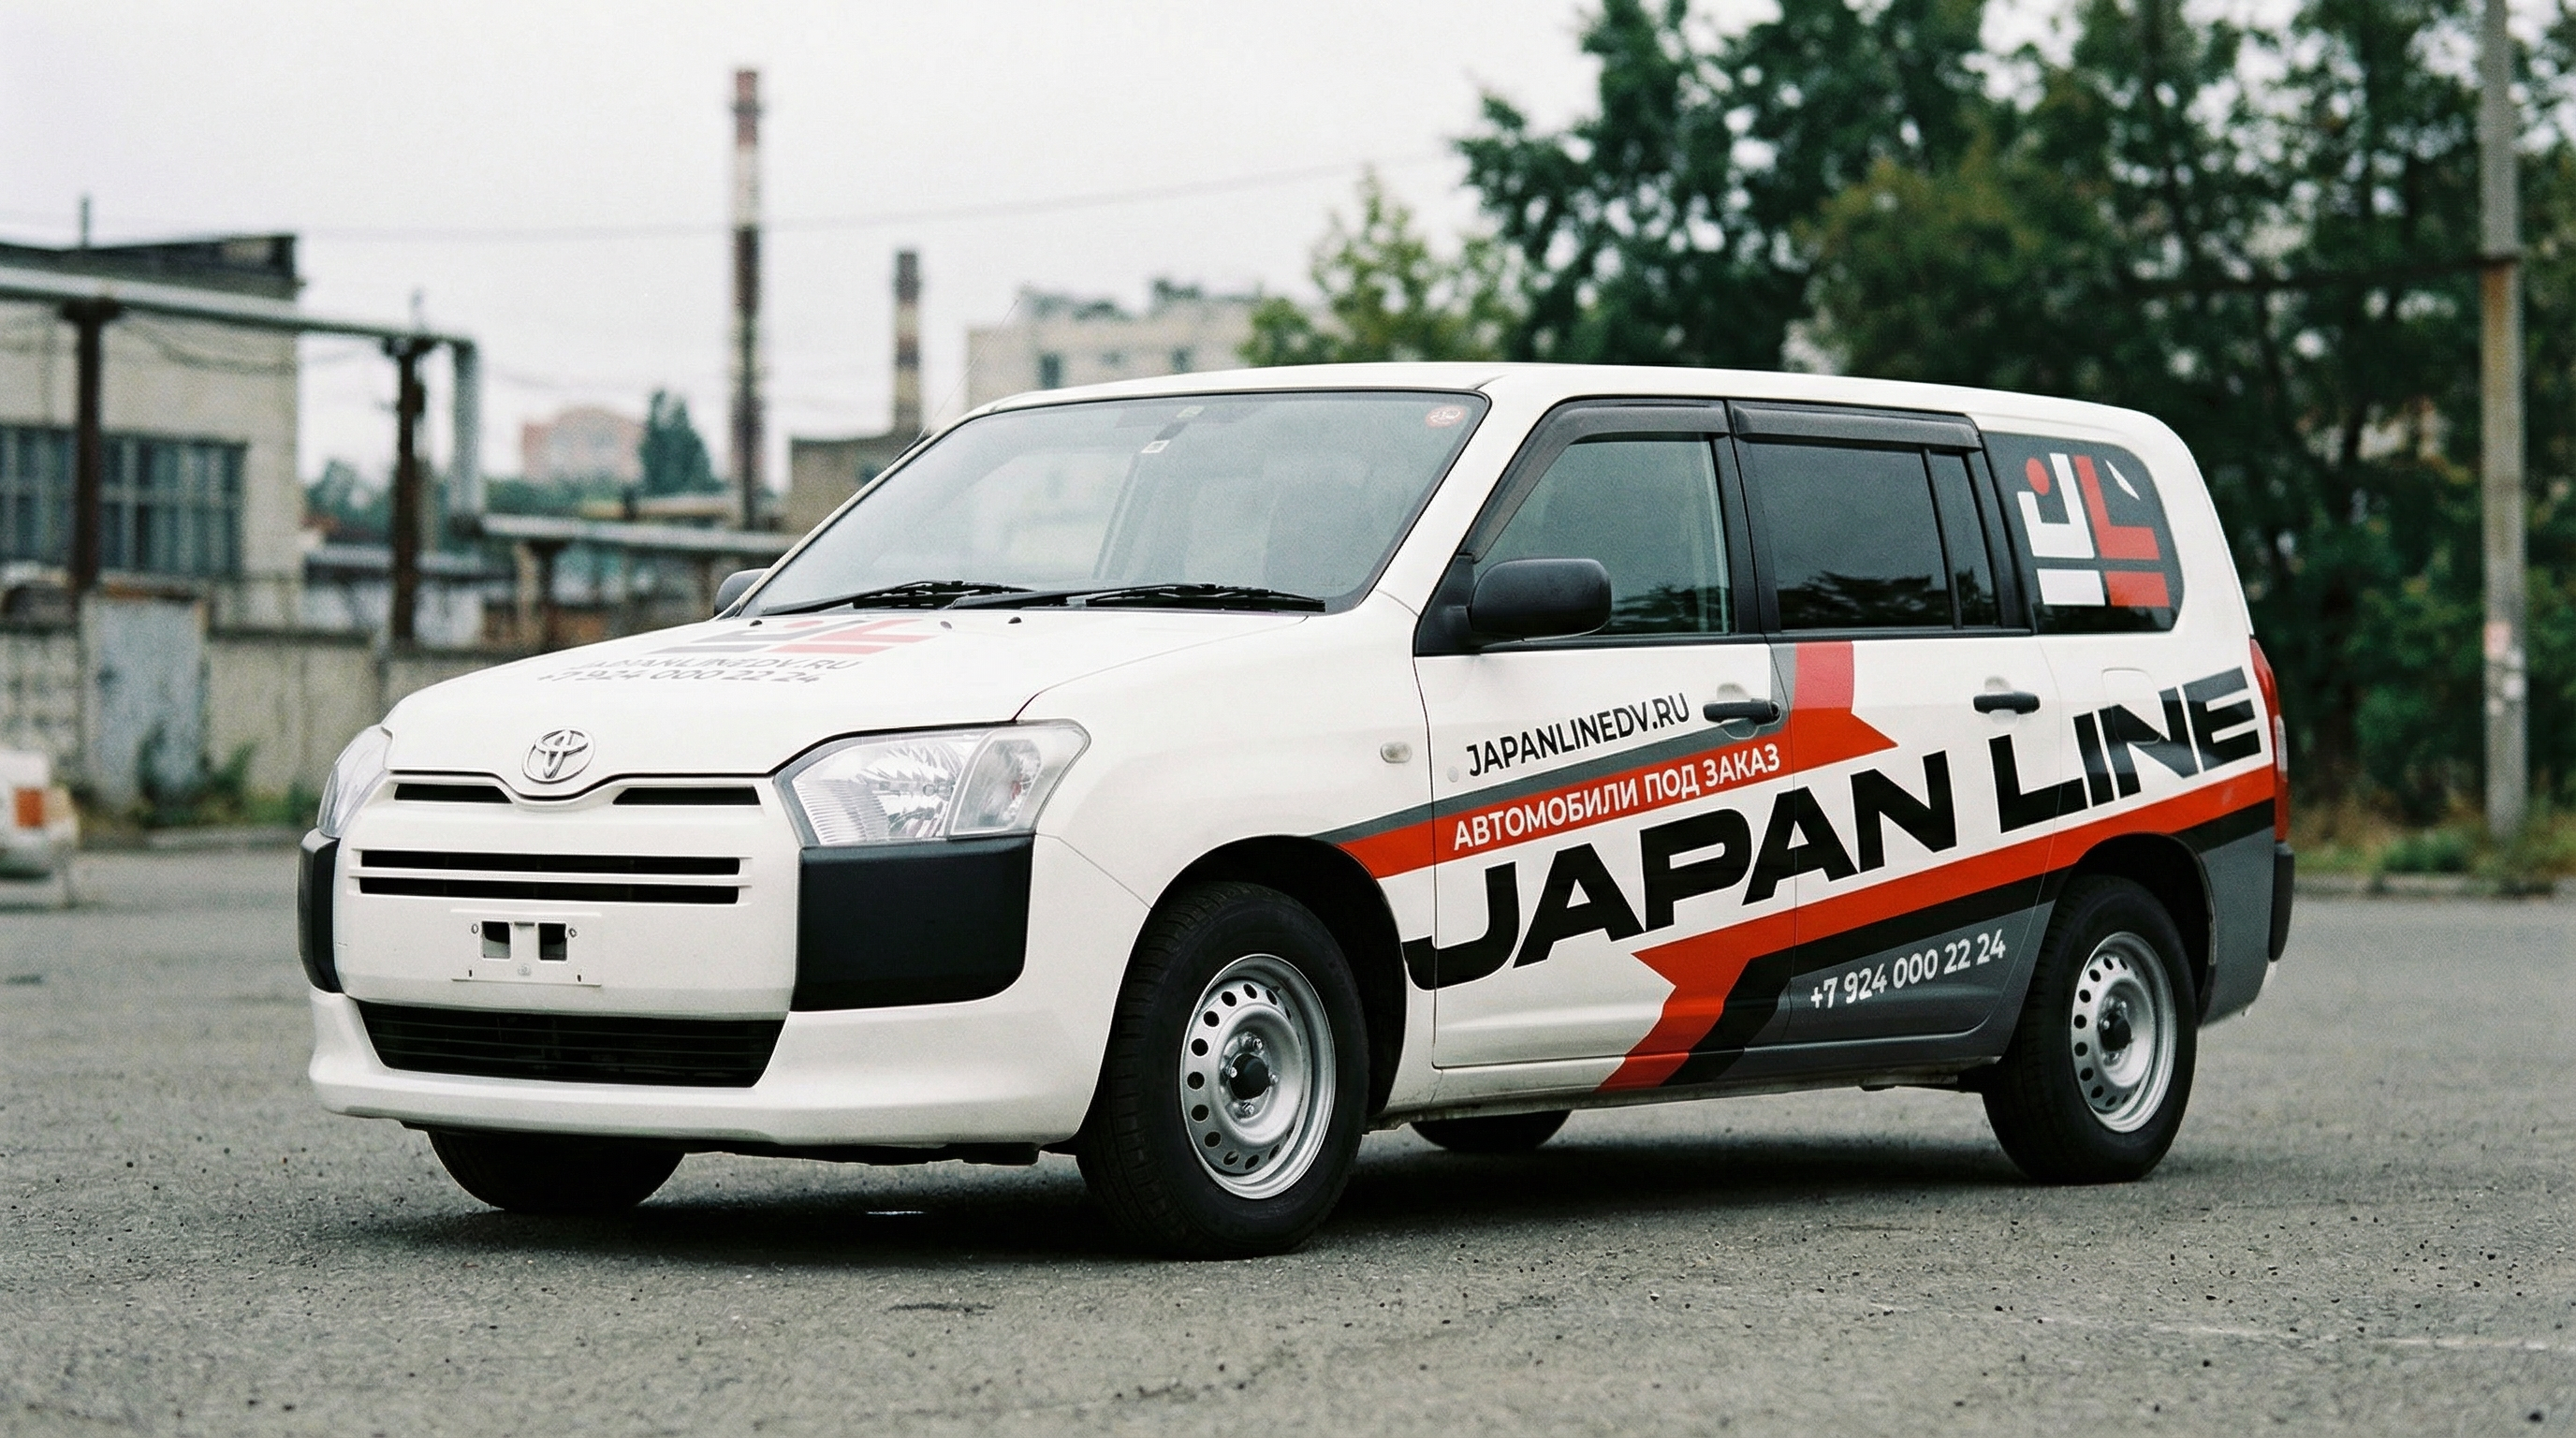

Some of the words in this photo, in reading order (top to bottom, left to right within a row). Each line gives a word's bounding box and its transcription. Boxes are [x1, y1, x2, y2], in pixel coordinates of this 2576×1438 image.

[575, 669, 650, 681] 924
[650, 669, 724, 680] 000
[721, 670, 775, 682] 22
[770, 671, 826, 682] 24
[1466, 693, 1690, 776] JAPANLINEDV.RU
[1401, 749, 1957, 990] JAPAN
[1988, 666, 2262, 834] LINE
[1454, 778, 1638, 851] АВТОМОБИЛИ
[1644, 764, 1700, 802] ПОД
[1702, 742, 1780, 786] ЗАКАЗ
[1810, 976, 1838, 1009] +7
[1843, 962, 1888, 1005] 924
[1893, 948, 1939, 989] 000
[1943, 938, 1971, 975] 22
[1976, 928, 2006, 965] 24
